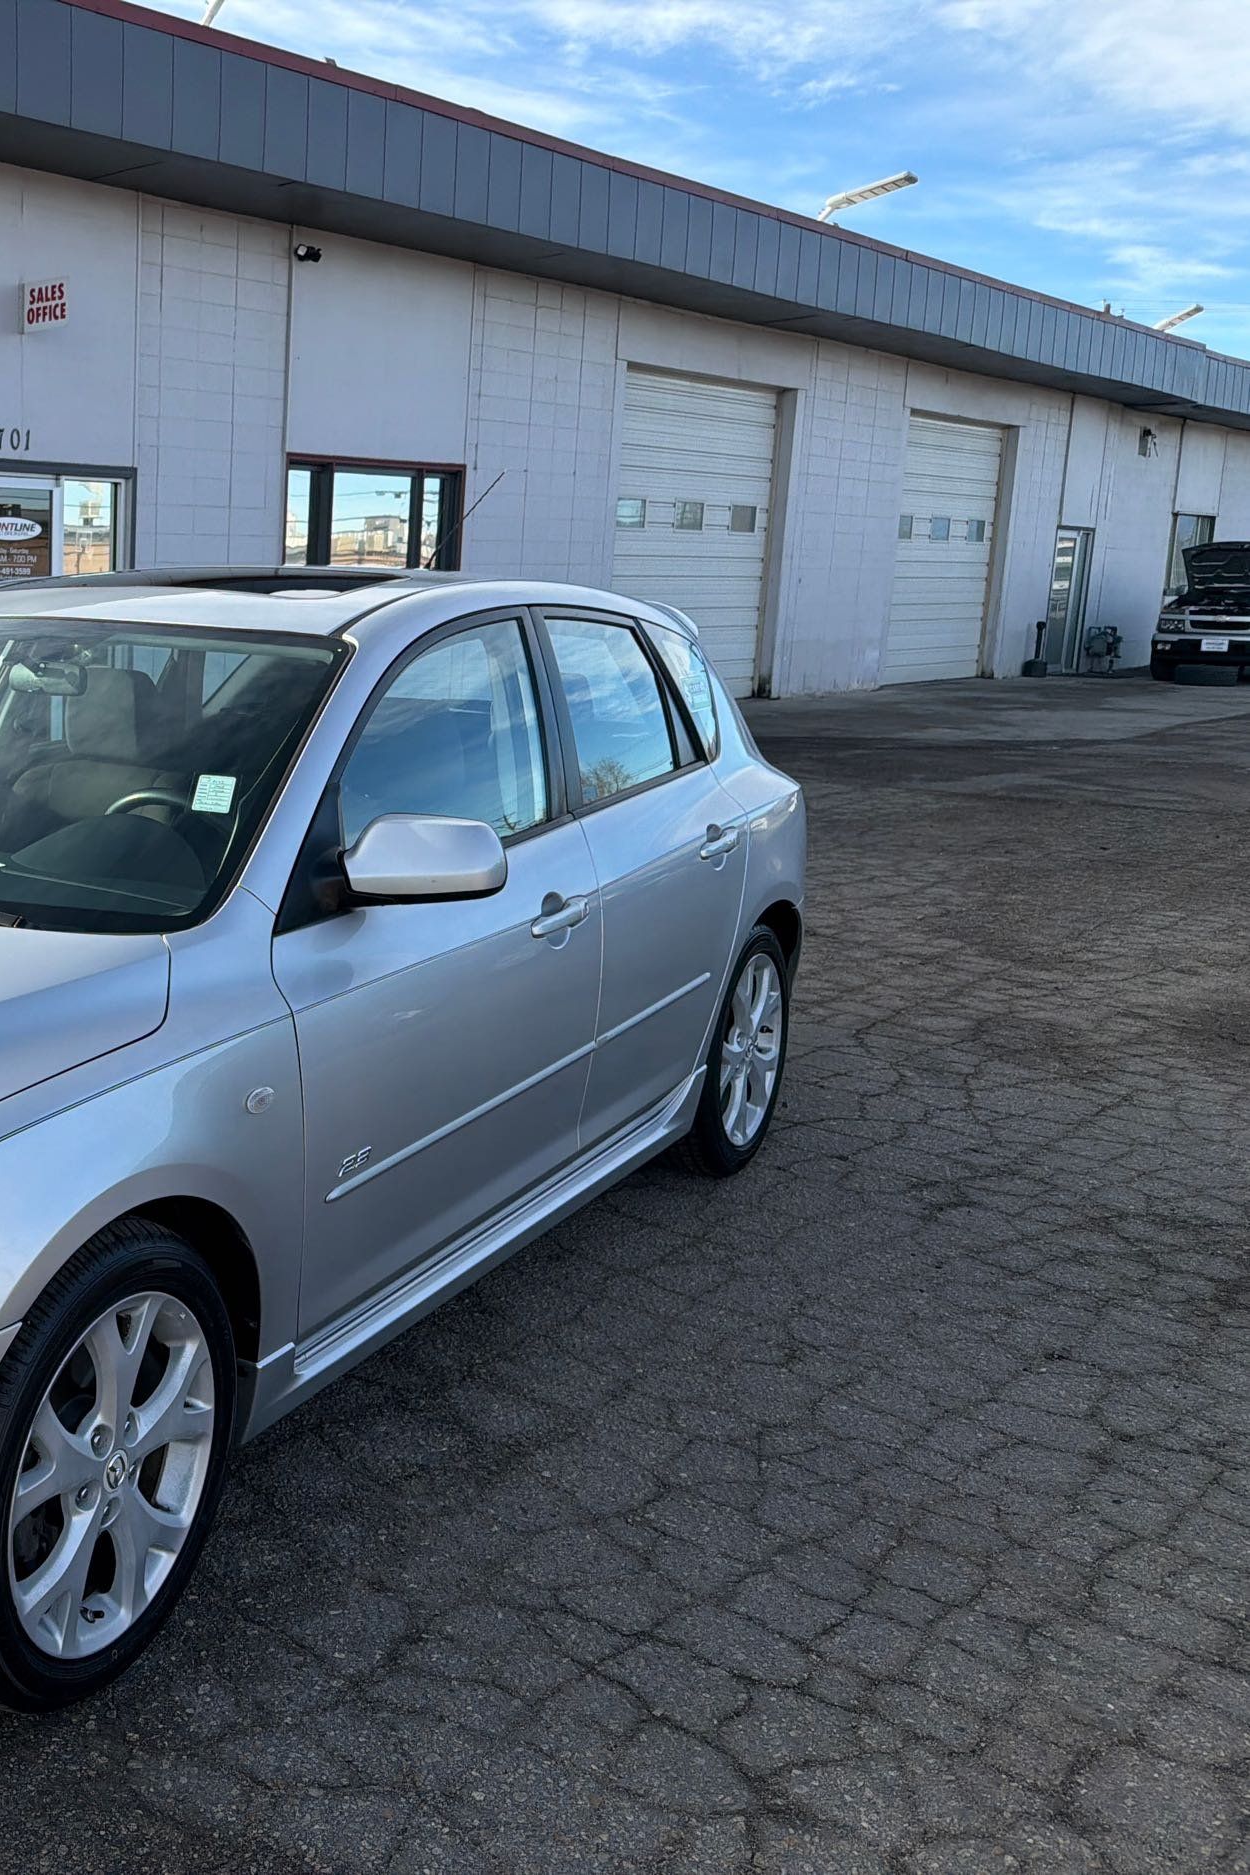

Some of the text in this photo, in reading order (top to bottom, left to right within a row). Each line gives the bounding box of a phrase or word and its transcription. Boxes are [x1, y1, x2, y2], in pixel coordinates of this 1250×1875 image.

[29, 283, 64, 305] SALES
[27, 302, 66, 325] OFFICE
[26, 555, 37, 563] PM
